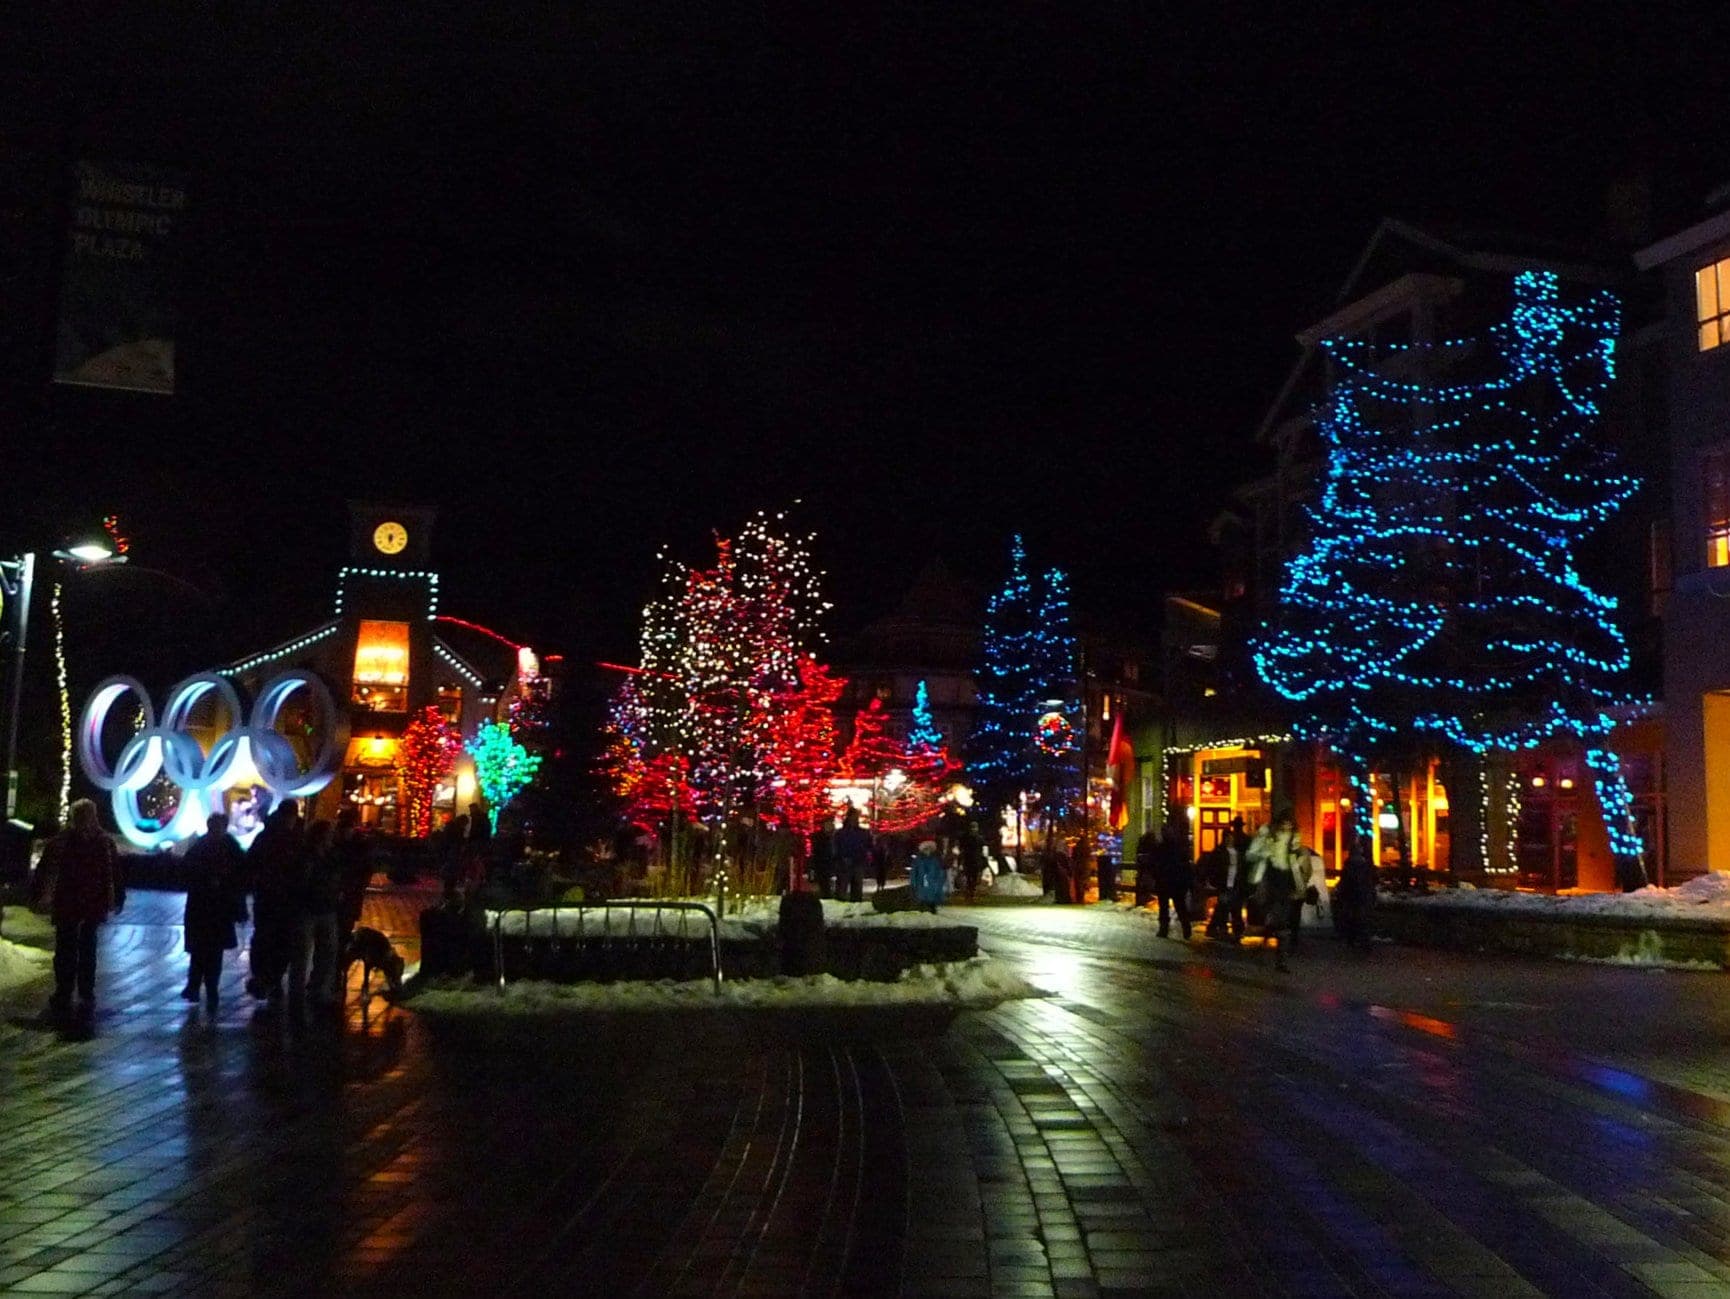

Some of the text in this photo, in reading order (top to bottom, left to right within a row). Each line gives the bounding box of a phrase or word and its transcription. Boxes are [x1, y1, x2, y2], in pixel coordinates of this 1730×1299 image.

[80, 178, 185, 208] WHISTLER
[77, 206, 170, 234] OLYMPIC
[74, 233, 143, 258] PLAZA
